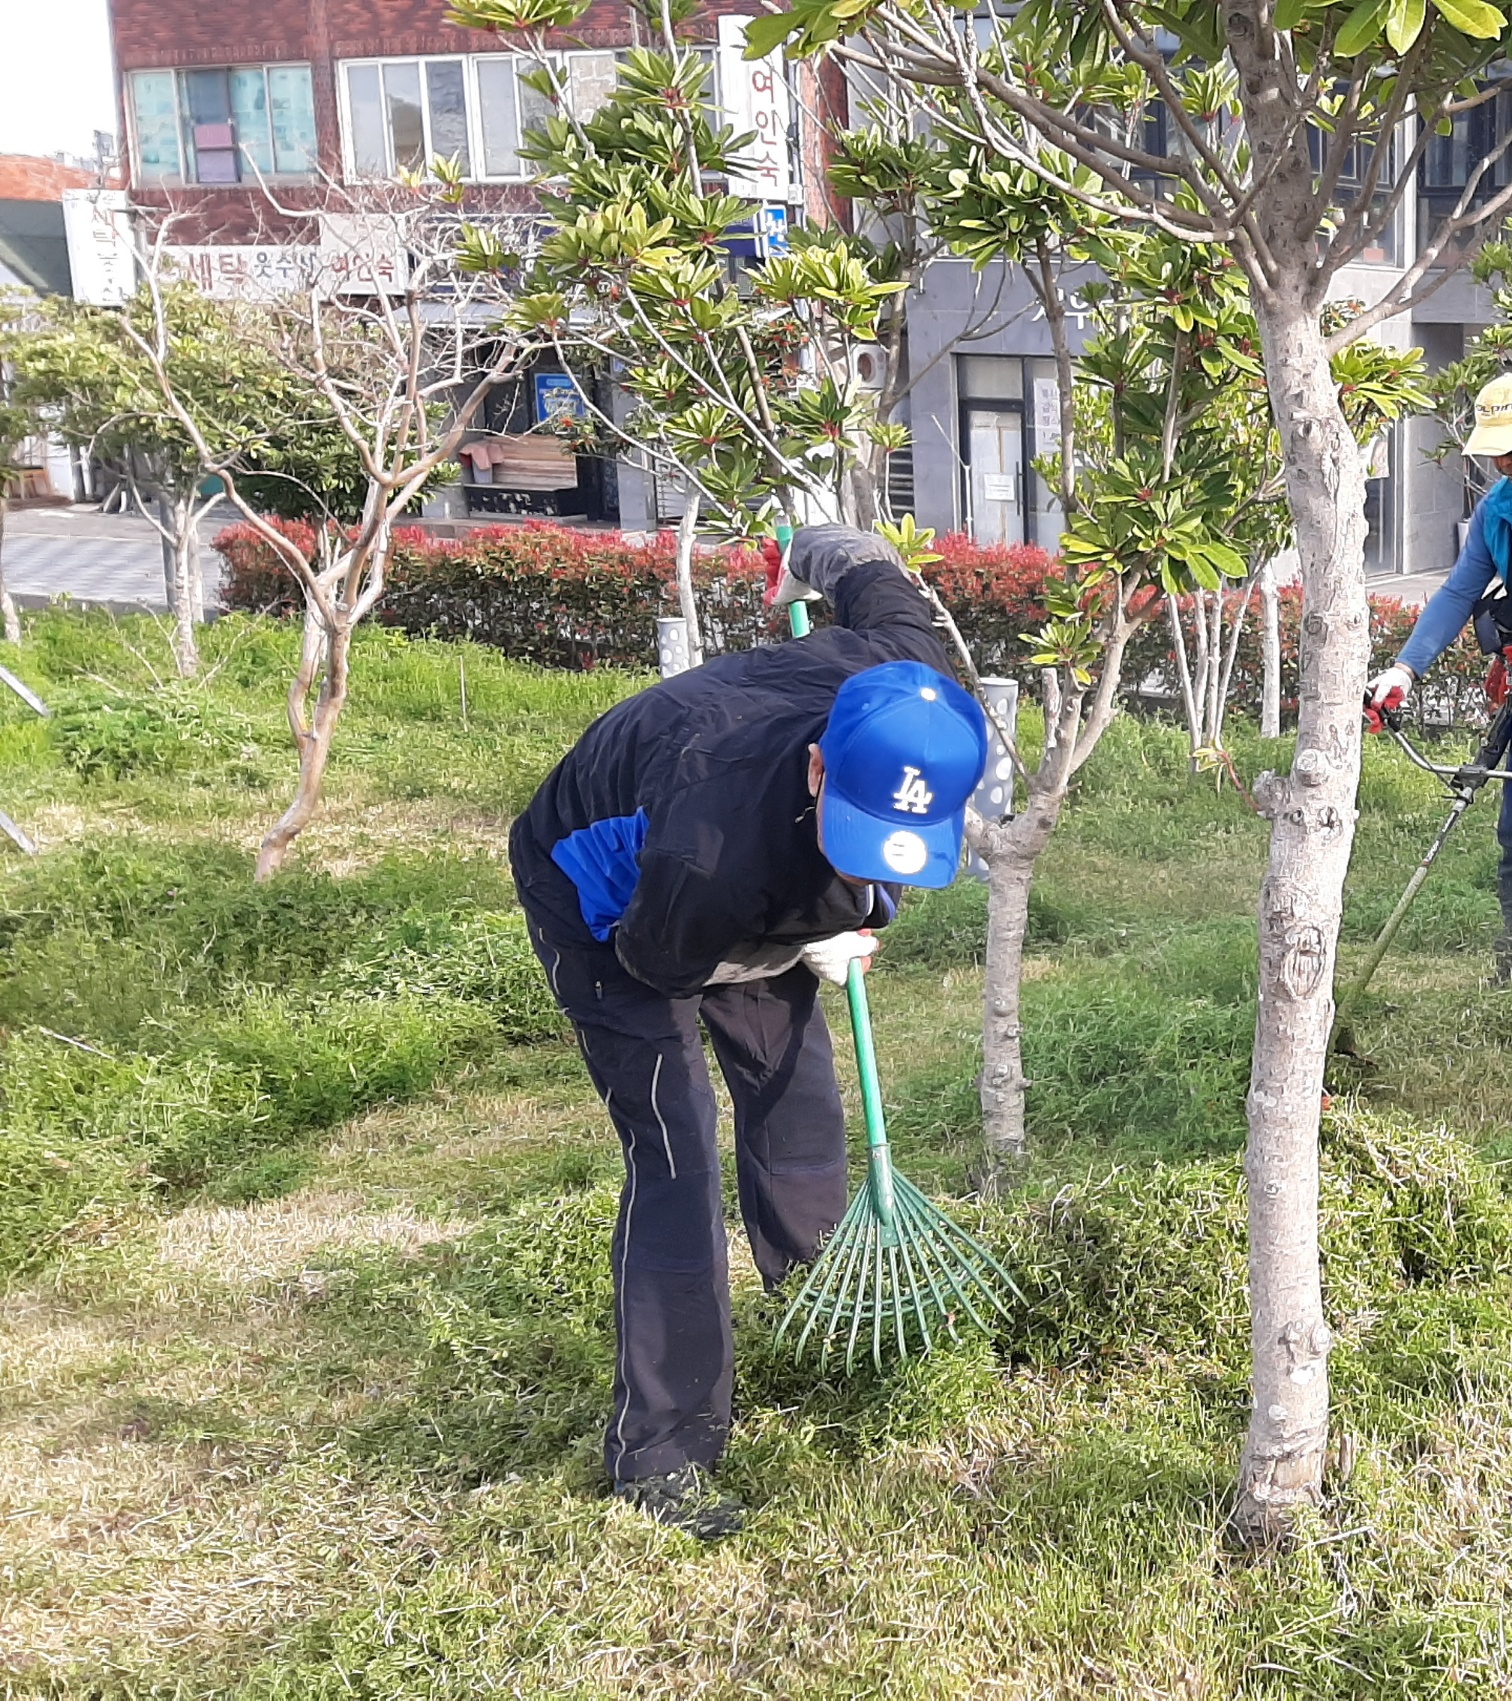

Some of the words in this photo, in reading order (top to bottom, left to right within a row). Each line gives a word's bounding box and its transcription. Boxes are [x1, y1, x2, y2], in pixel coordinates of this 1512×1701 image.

[751, 66, 780, 188] 여인숙
[189, 252, 246, 291] 세탁
[331, 252, 395, 283] 여인숙
[893, 765, 933, 814] LA
